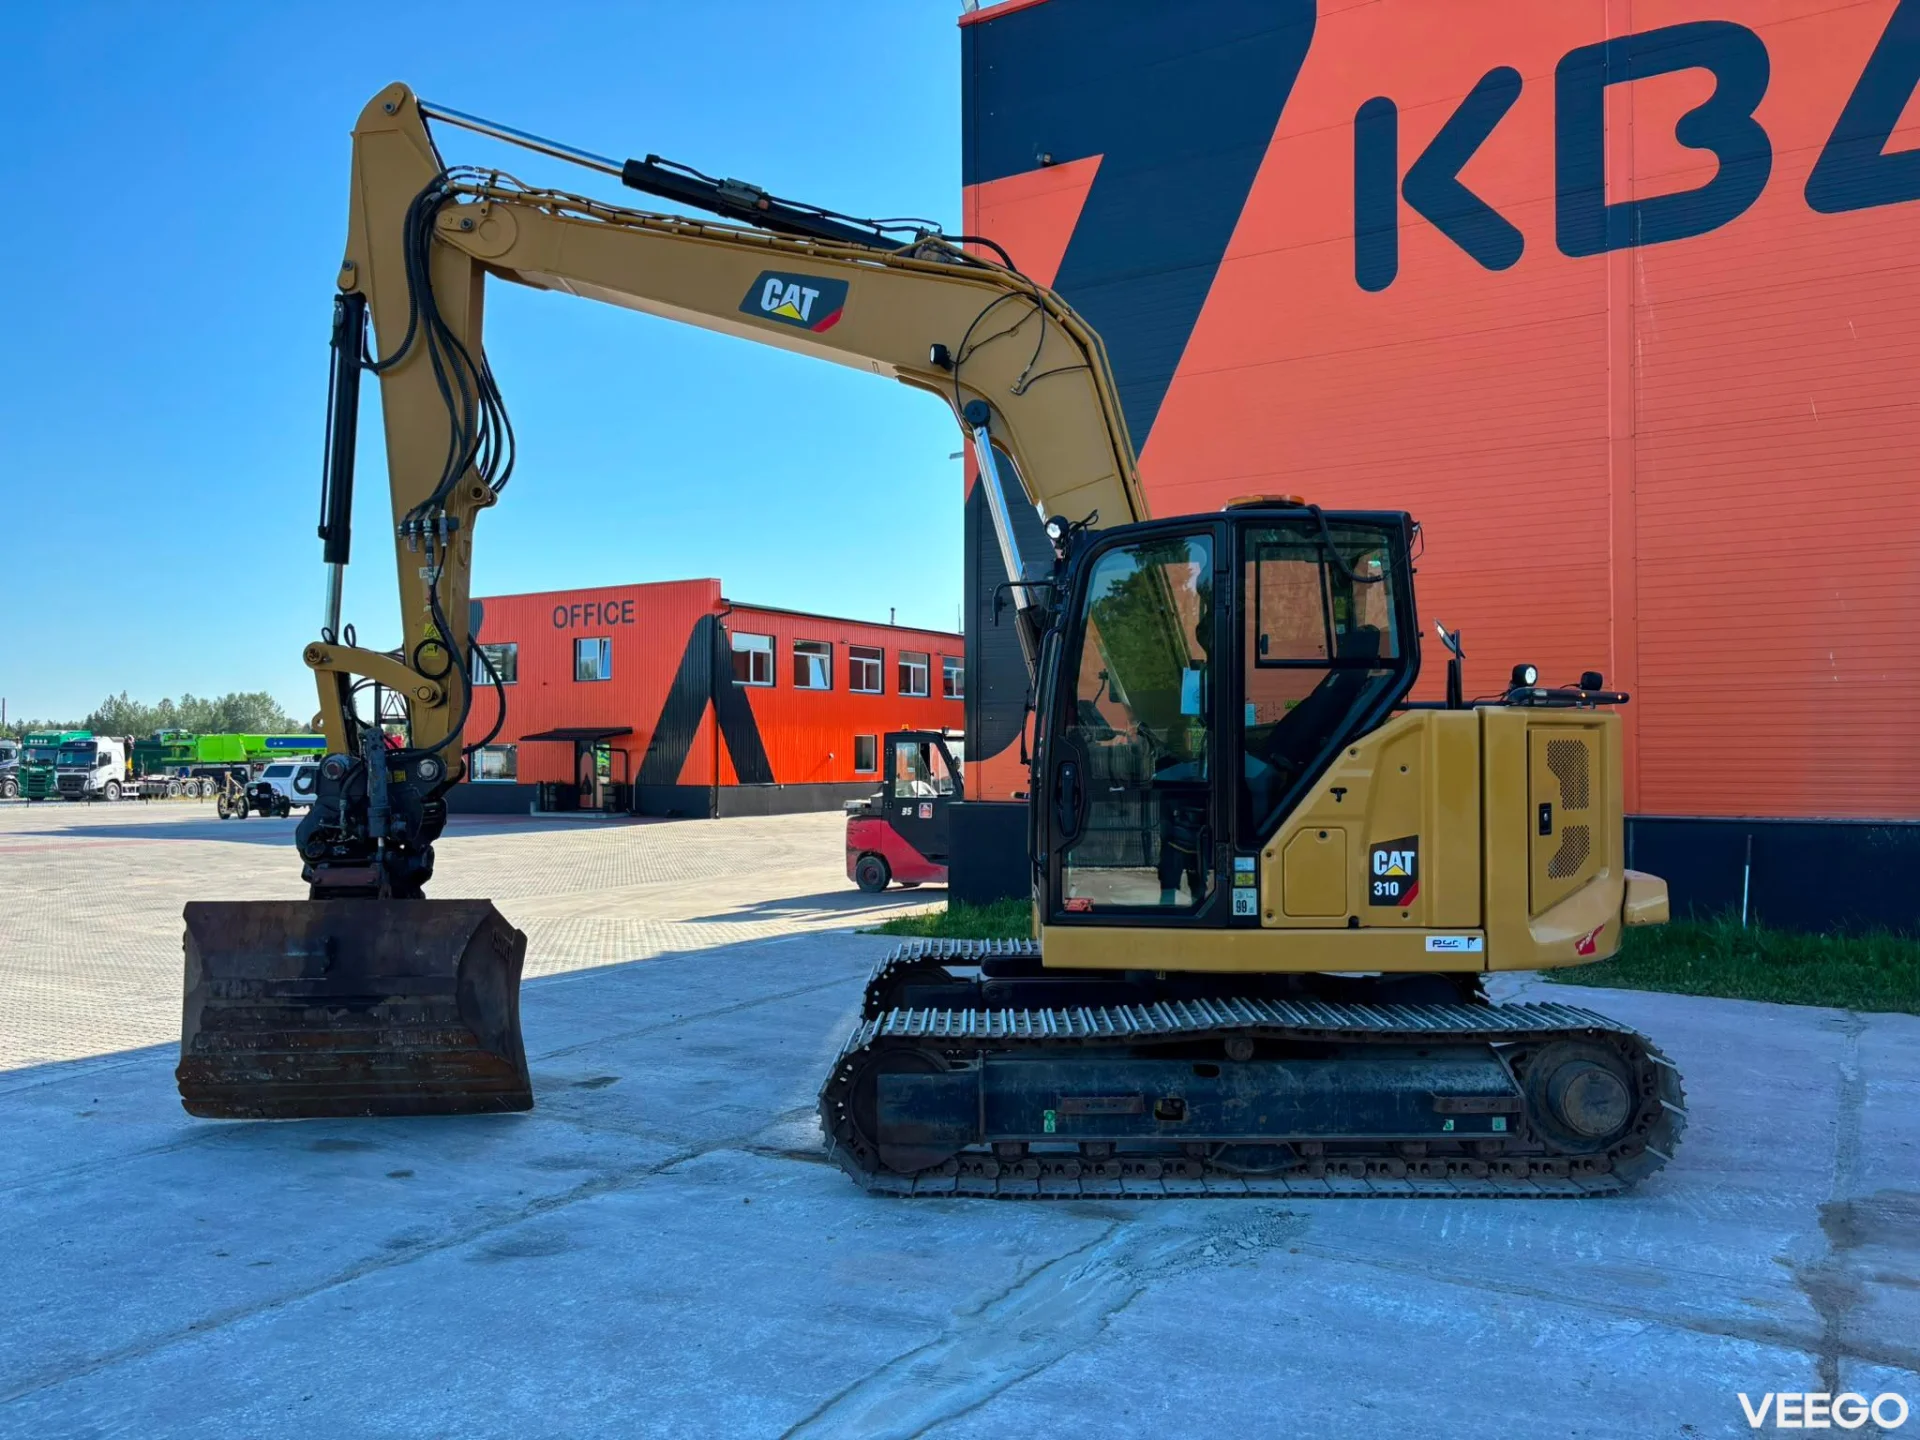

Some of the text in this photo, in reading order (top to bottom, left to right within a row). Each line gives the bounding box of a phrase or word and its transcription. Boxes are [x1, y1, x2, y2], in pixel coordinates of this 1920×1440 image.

[760, 277, 820, 322] CAT
[553, 600, 635, 629] OFFICE
[1373, 850, 1415, 876] CAT
[1373, 881, 1399, 896] 310
[1236, 899, 1247, 913] 99
